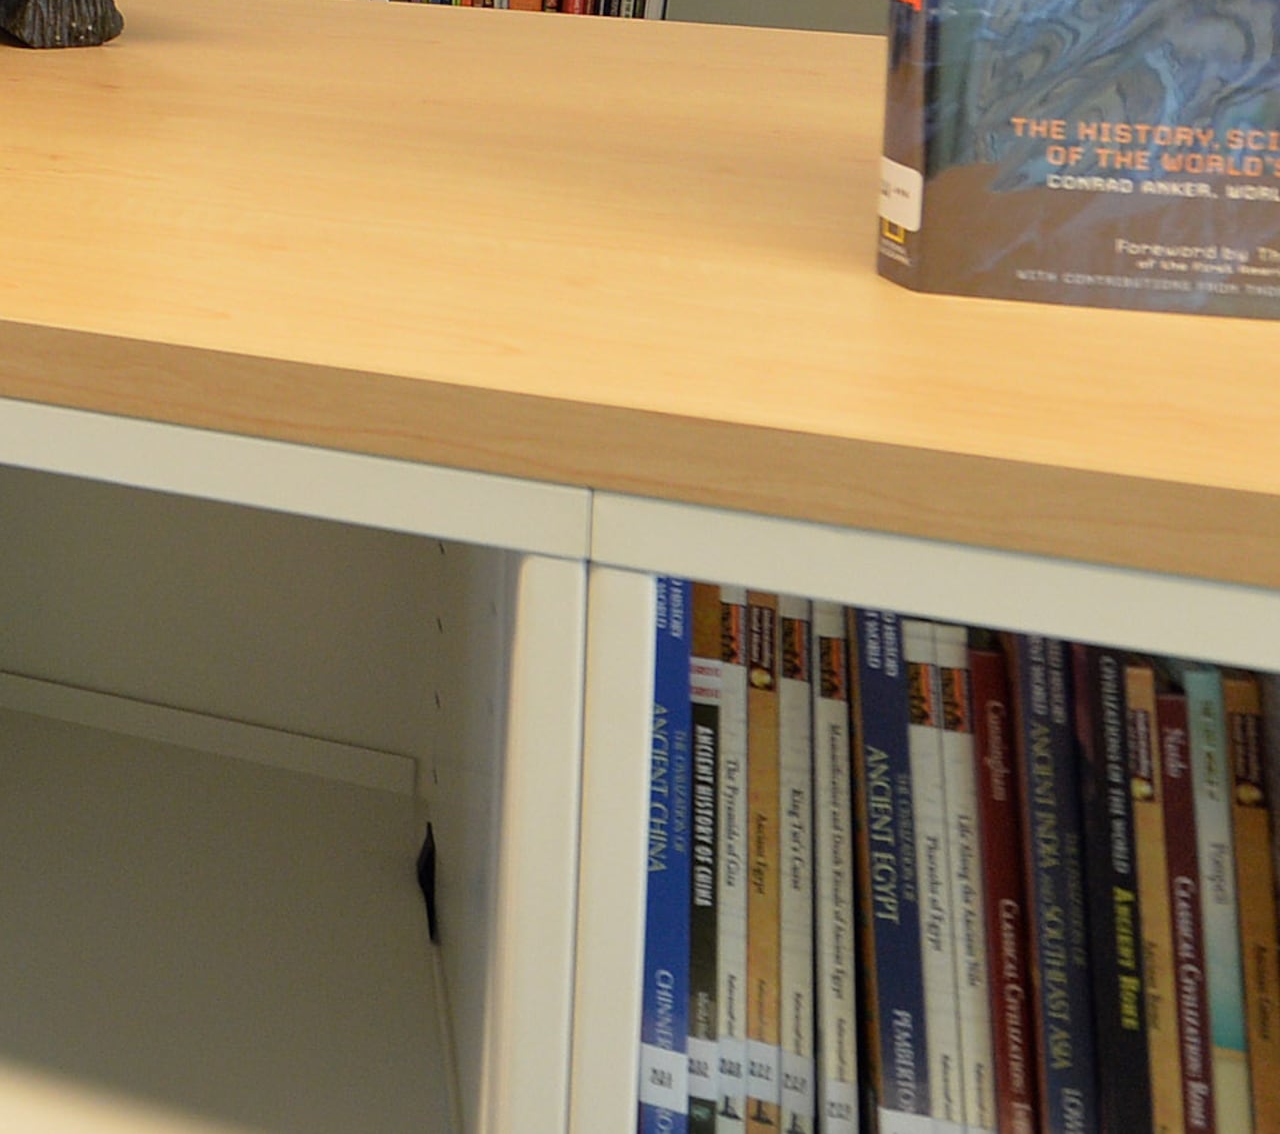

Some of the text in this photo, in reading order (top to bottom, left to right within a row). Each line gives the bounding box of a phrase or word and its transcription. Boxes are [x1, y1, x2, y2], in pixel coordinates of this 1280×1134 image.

[1011, 117, 1067, 140] THE
[1046, 146, 1085, 166] OF
[1095, 148, 1151, 171] THE
[1046, 174, 1134, 194] CONRAD
[1115, 238, 1218, 260] Foreword
[695, 723, 714, 784] ANCIENT
[1029, 719, 1056, 805] ANCIENT
[646, 702, 670, 873] ANCIENT CHINA
[695, 784, 714, 844] HISTORY
[724, 783, 740, 842] Pyramids
[1107, 787, 1127, 816] THE
[695, 845, 713, 865] OF
[866, 744, 901, 925] ANCIENT EGYPT
[1034, 810, 1060, 868] INDIA
[1110, 819, 1131, 874] WORLD
[694, 865, 713, 907] CHINA
[998, 898, 1022, 978] CLASSICAL
[1040, 905, 1071, 1019] SOUTHEAST
[1112, 886, 1140, 1031] ANCIENT ROME
[1172, 875, 1210, 1128] CLASSICAL ROME
[1048, 1024, 1074, 1070] ASIA
